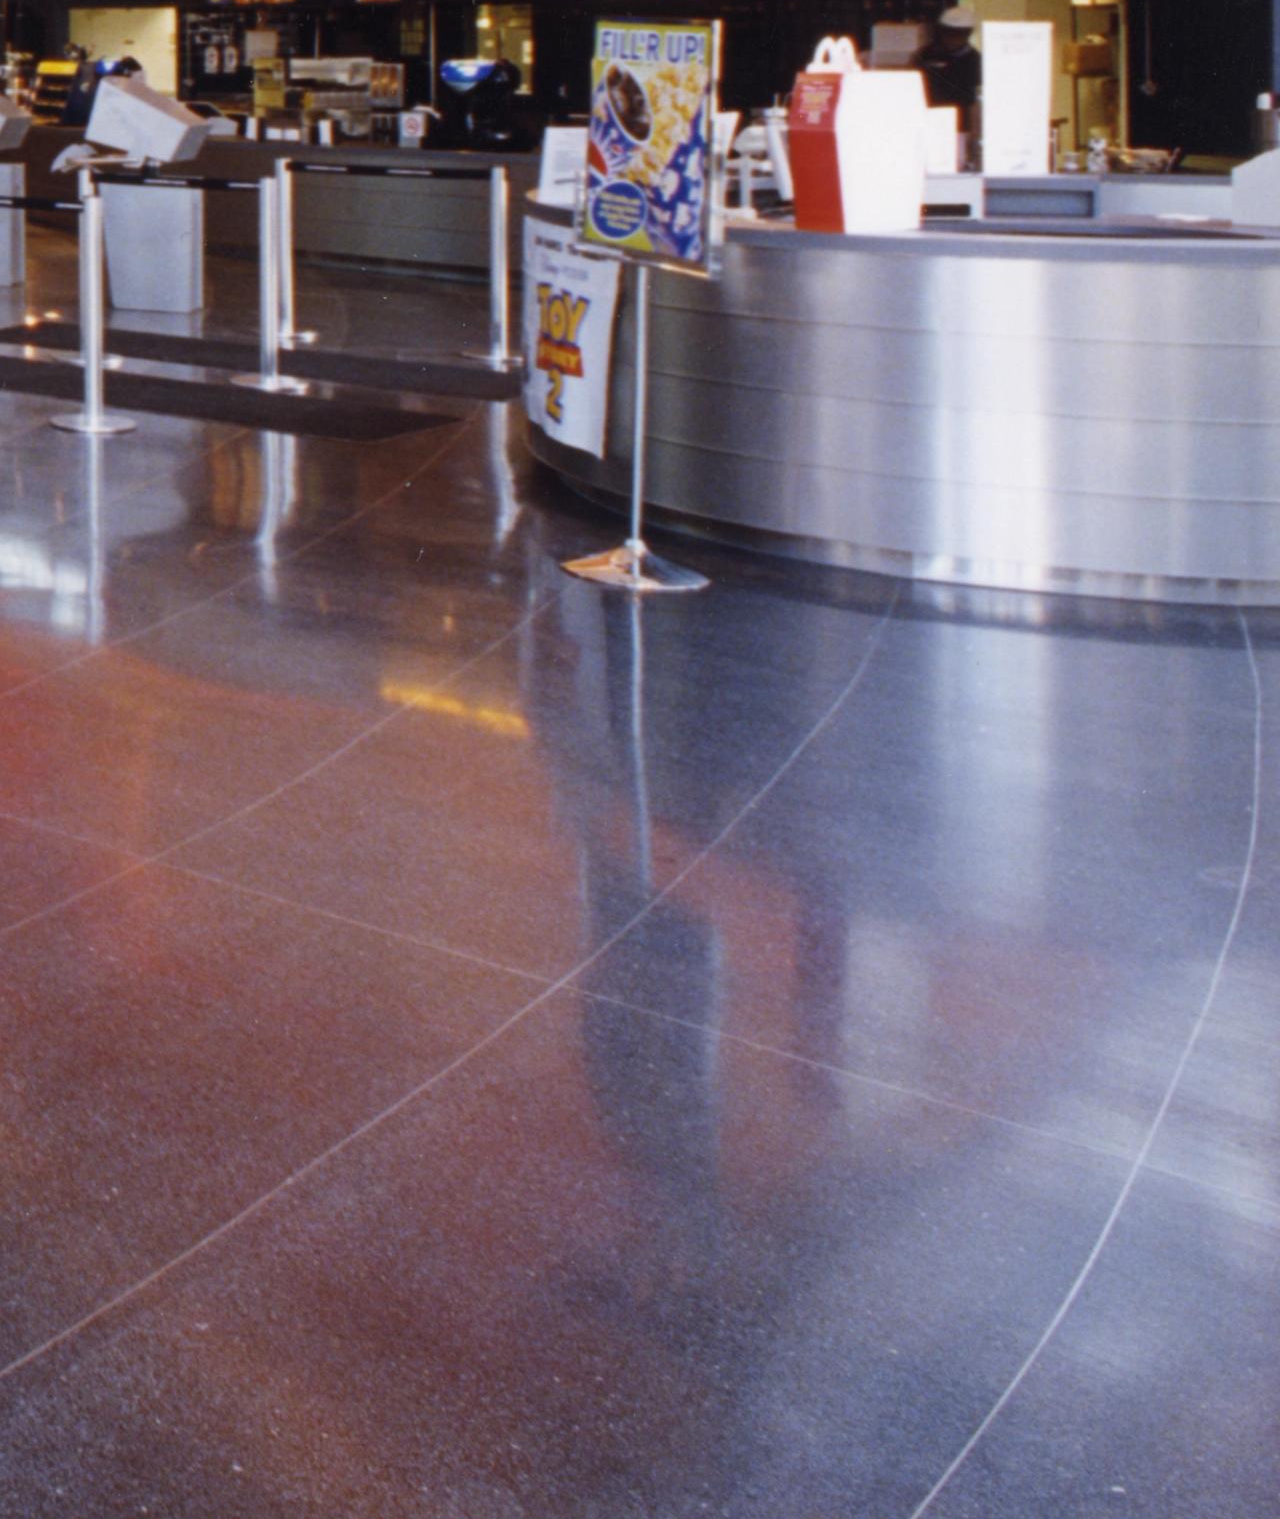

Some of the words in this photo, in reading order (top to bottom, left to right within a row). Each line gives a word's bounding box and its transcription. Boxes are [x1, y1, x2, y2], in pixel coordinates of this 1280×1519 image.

[600, 31, 660, 62] FILL'R
[666, 34, 705, 65] UP!
[537, 282, 591, 347] TOY
[546, 367, 564, 425] 2
